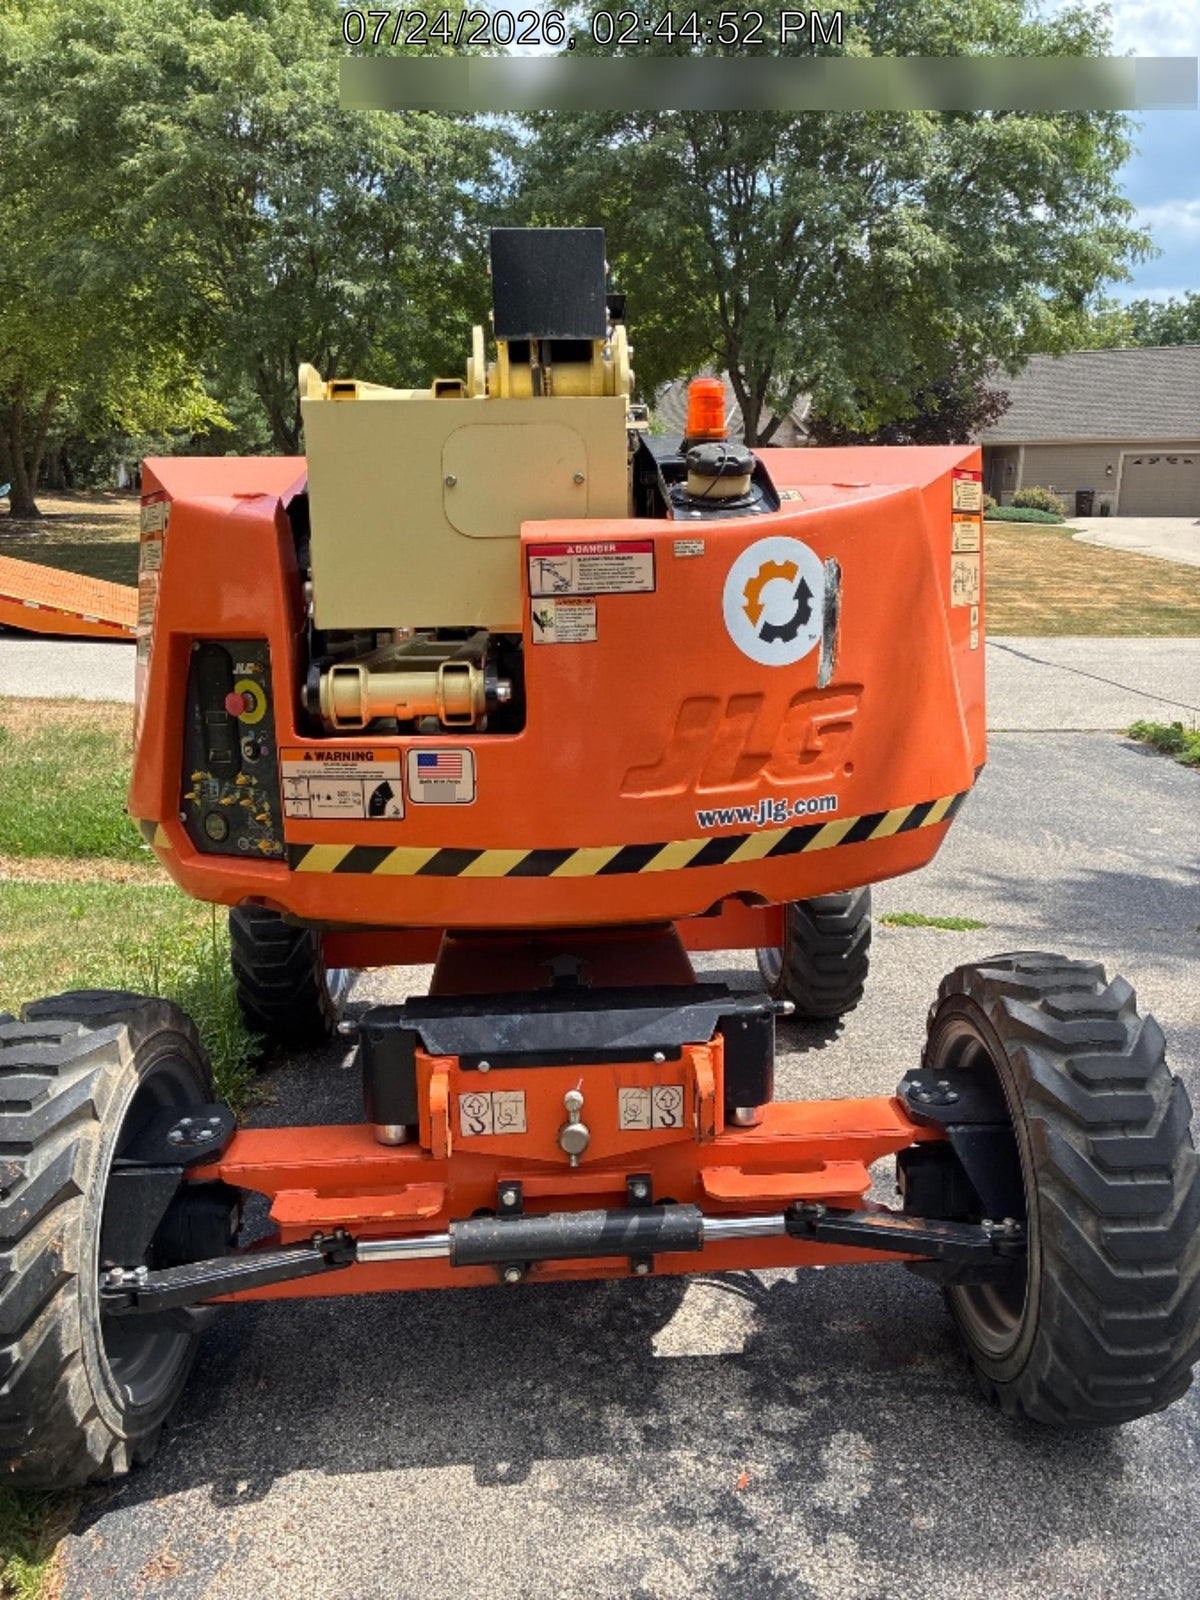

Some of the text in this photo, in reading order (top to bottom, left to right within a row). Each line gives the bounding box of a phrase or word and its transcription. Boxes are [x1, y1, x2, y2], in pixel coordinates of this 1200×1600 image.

[575, 544, 616, 554] DANGER
[314, 751, 374, 761] WARNING
[696, 795, 838, 828] www.jlg.com
